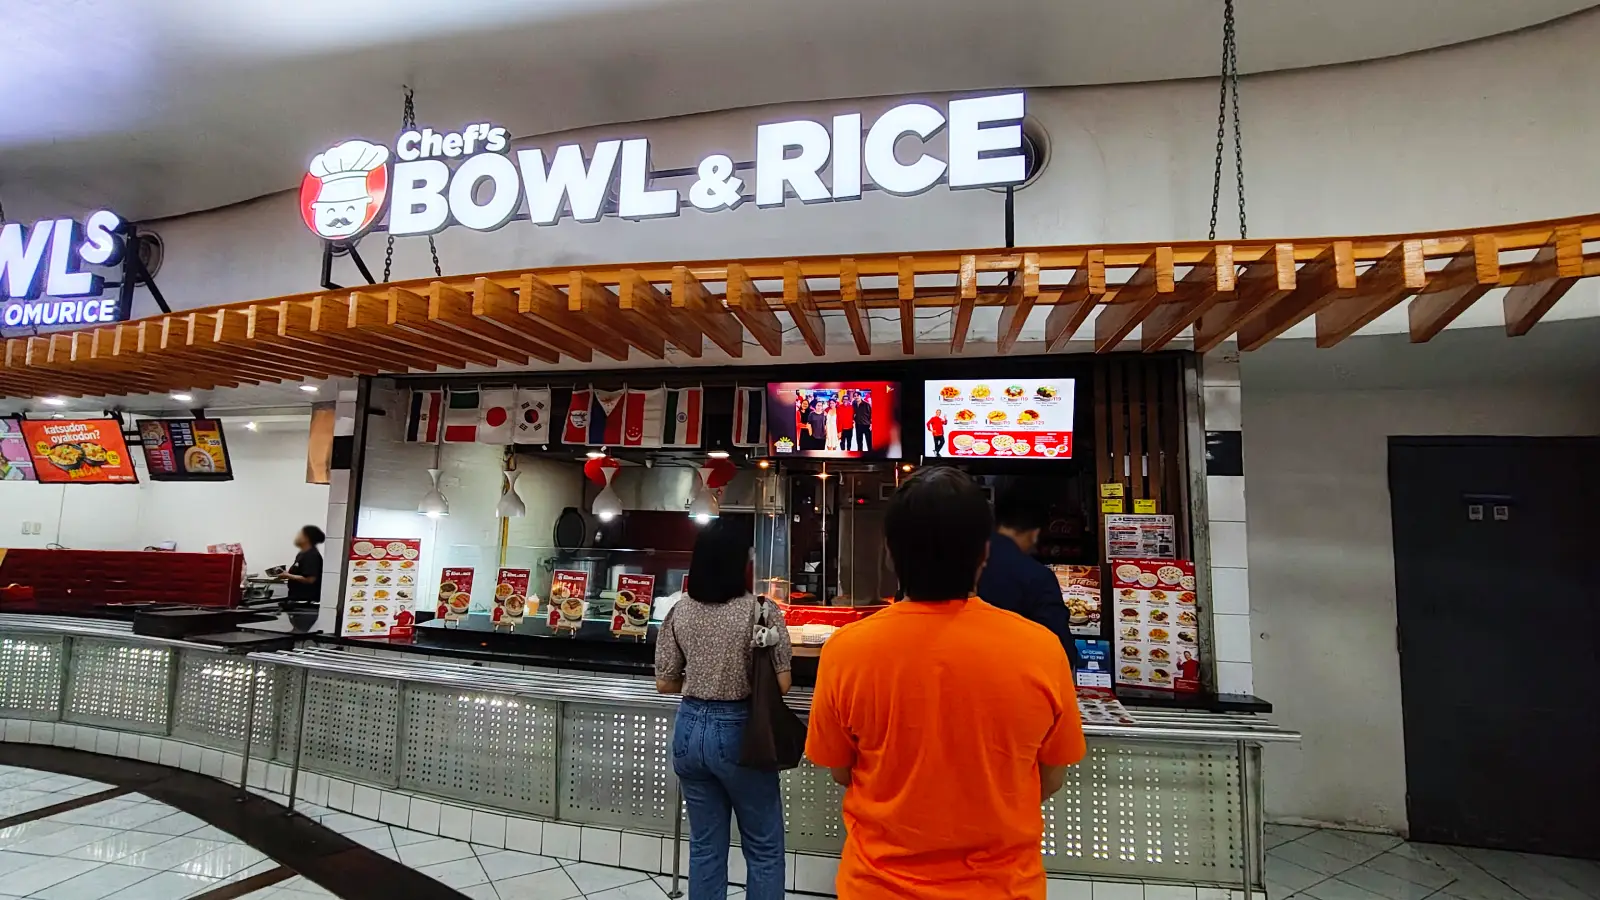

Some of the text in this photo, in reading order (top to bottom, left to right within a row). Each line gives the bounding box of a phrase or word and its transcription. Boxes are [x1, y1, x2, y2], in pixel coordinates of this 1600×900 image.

[396, 122, 507, 160] Chef's
[389, 92, 1027, 236] BOWL & RICE
[4, 299, 115, 326] OMURICE
[44, 423, 87, 435] katsudon
[51, 430, 100, 443] oyakodon?
